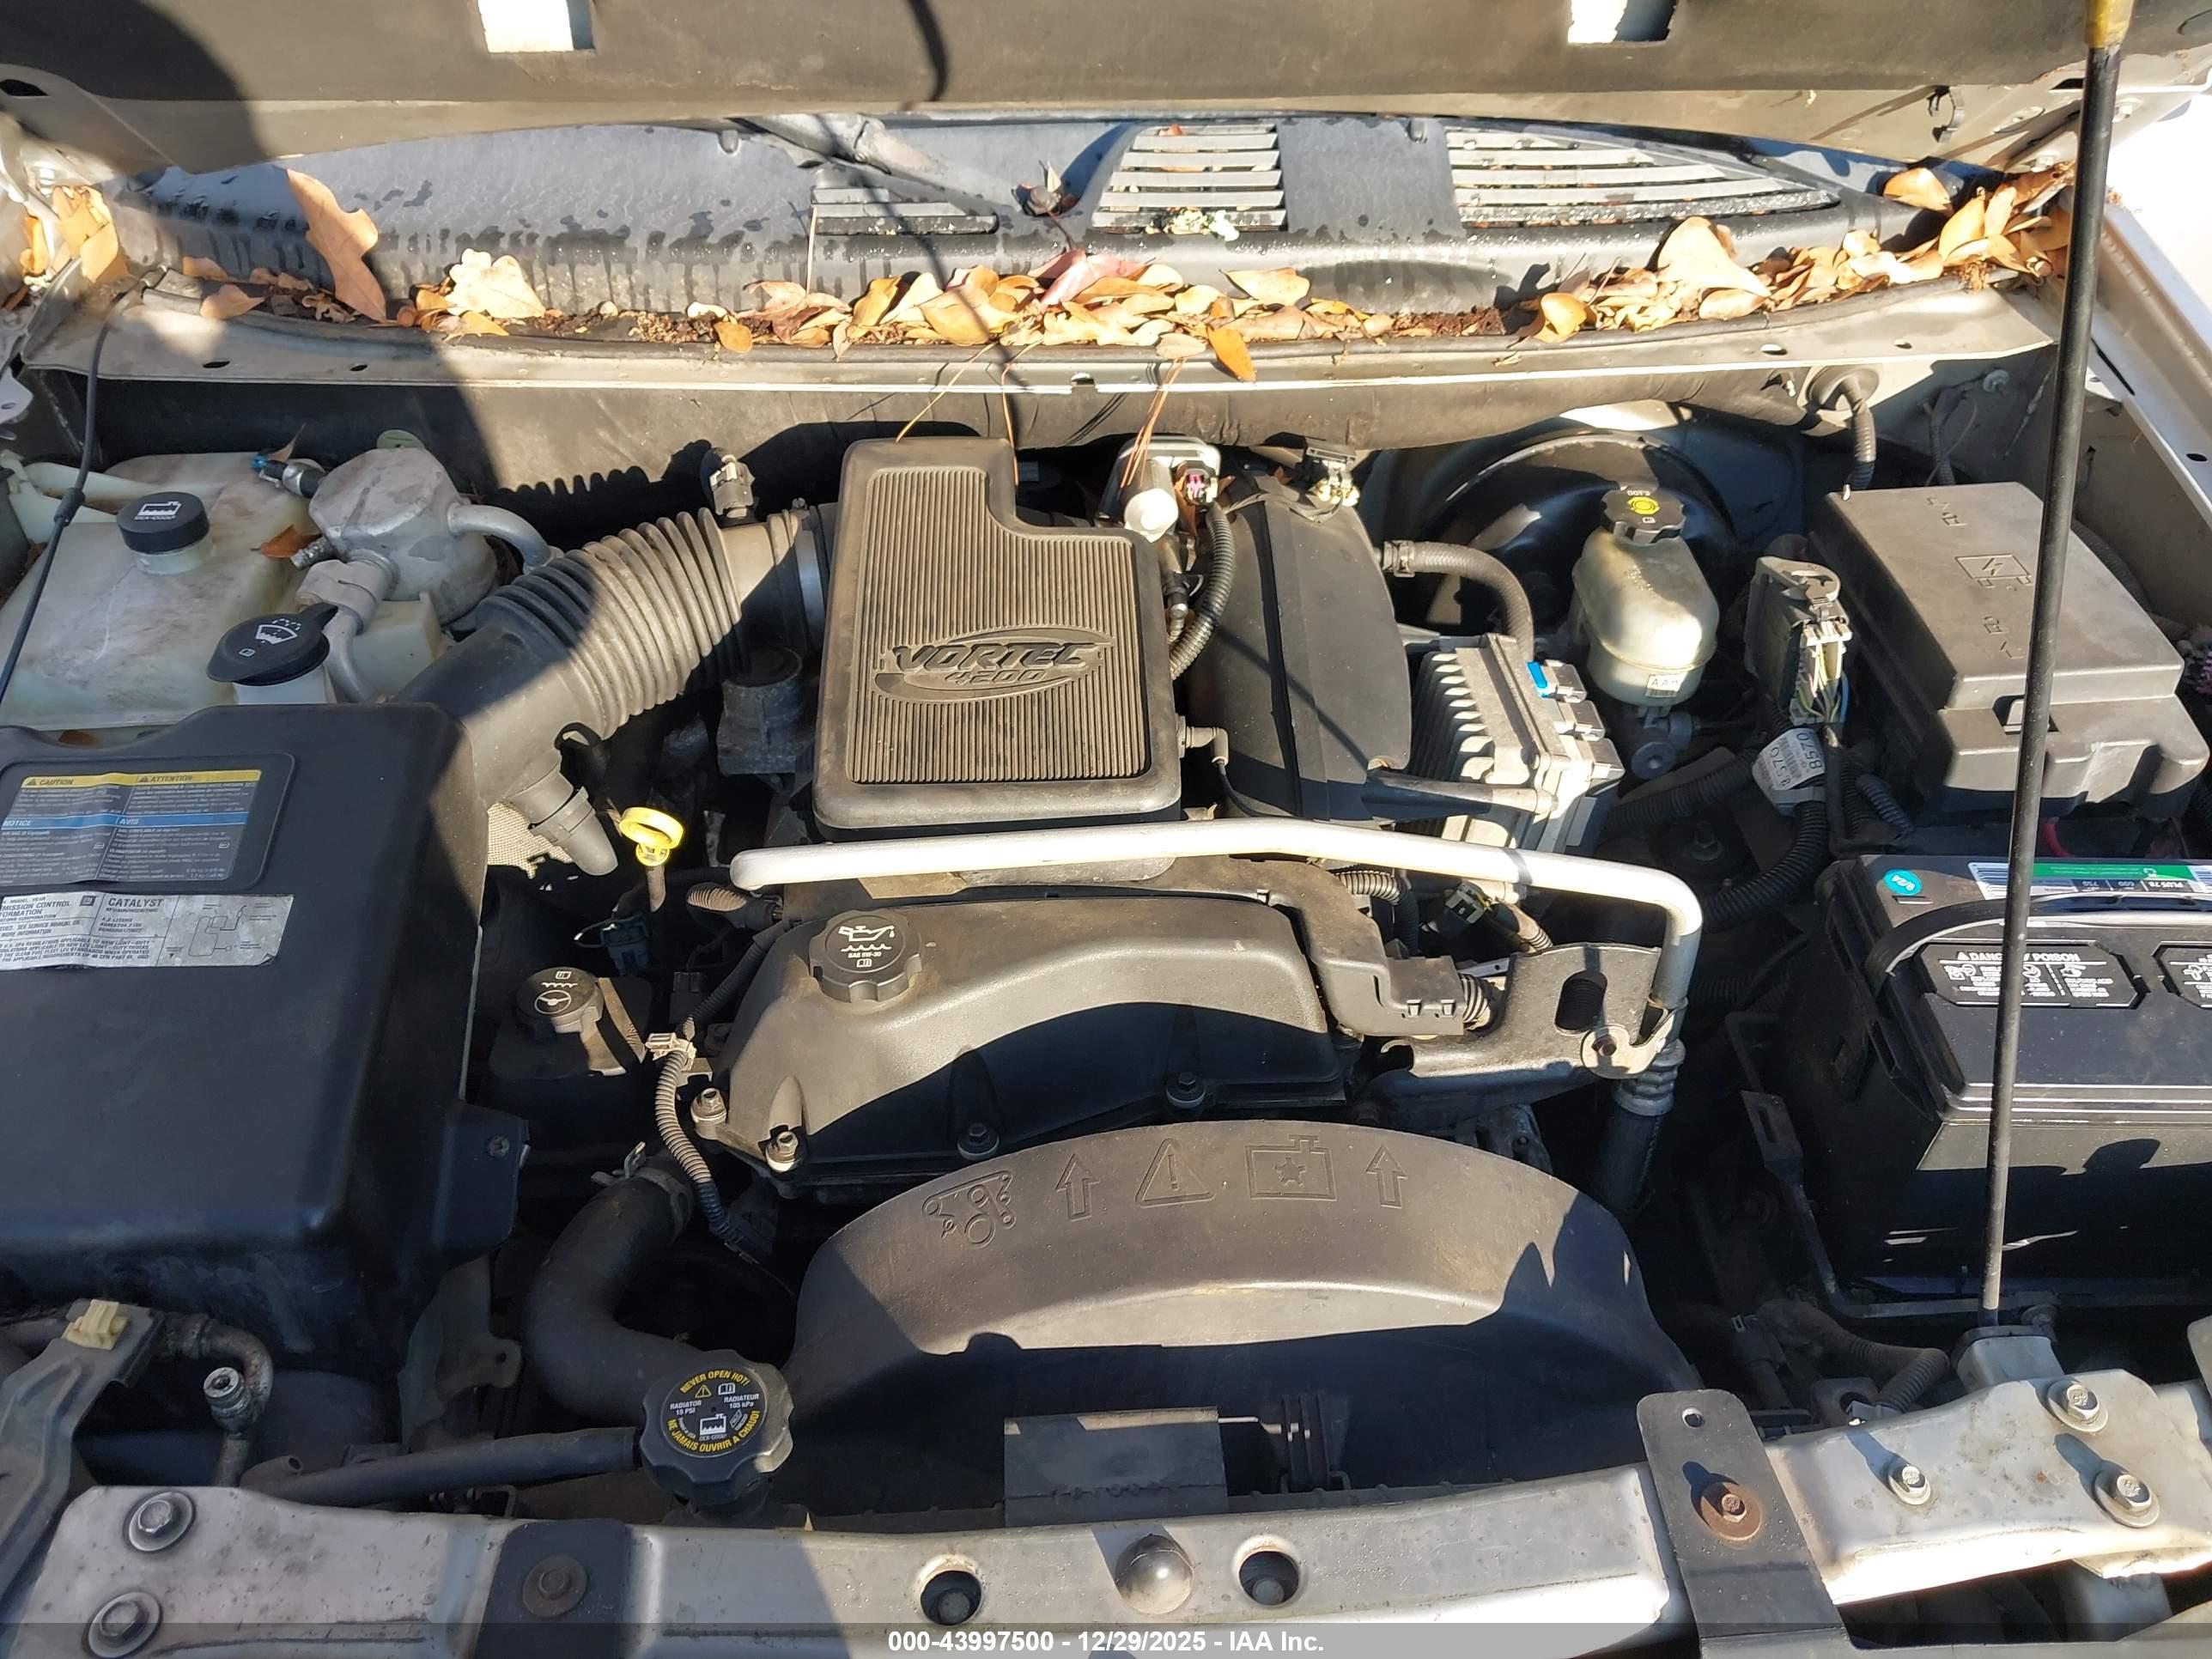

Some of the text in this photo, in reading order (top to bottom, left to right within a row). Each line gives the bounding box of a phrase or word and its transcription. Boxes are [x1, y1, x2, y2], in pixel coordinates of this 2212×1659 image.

[892, 642, 1096, 671] VORTEC
[945, 669, 1045, 684] 4200
[1796, 732, 1822, 769] 8570
[108, 897, 164, 907] CATALYST
[0, 908, 43, 917] FORMATION
[1970, 952, 2002, 961] DANG
[2033, 953, 2081, 962] POISON
[679, 1370, 750, 1394] NEVER OPEN HOT!
[724, 1393, 760, 1403] RADIATEUR
[669, 1401, 702, 1410] RADIATOR
[667, 1419, 677, 1431] NE
[672, 1429, 699, 1451] JAMAIS
[699, 1439, 732, 1453] OUVRIR
[738, 1410, 761, 1438] CHAUD!
